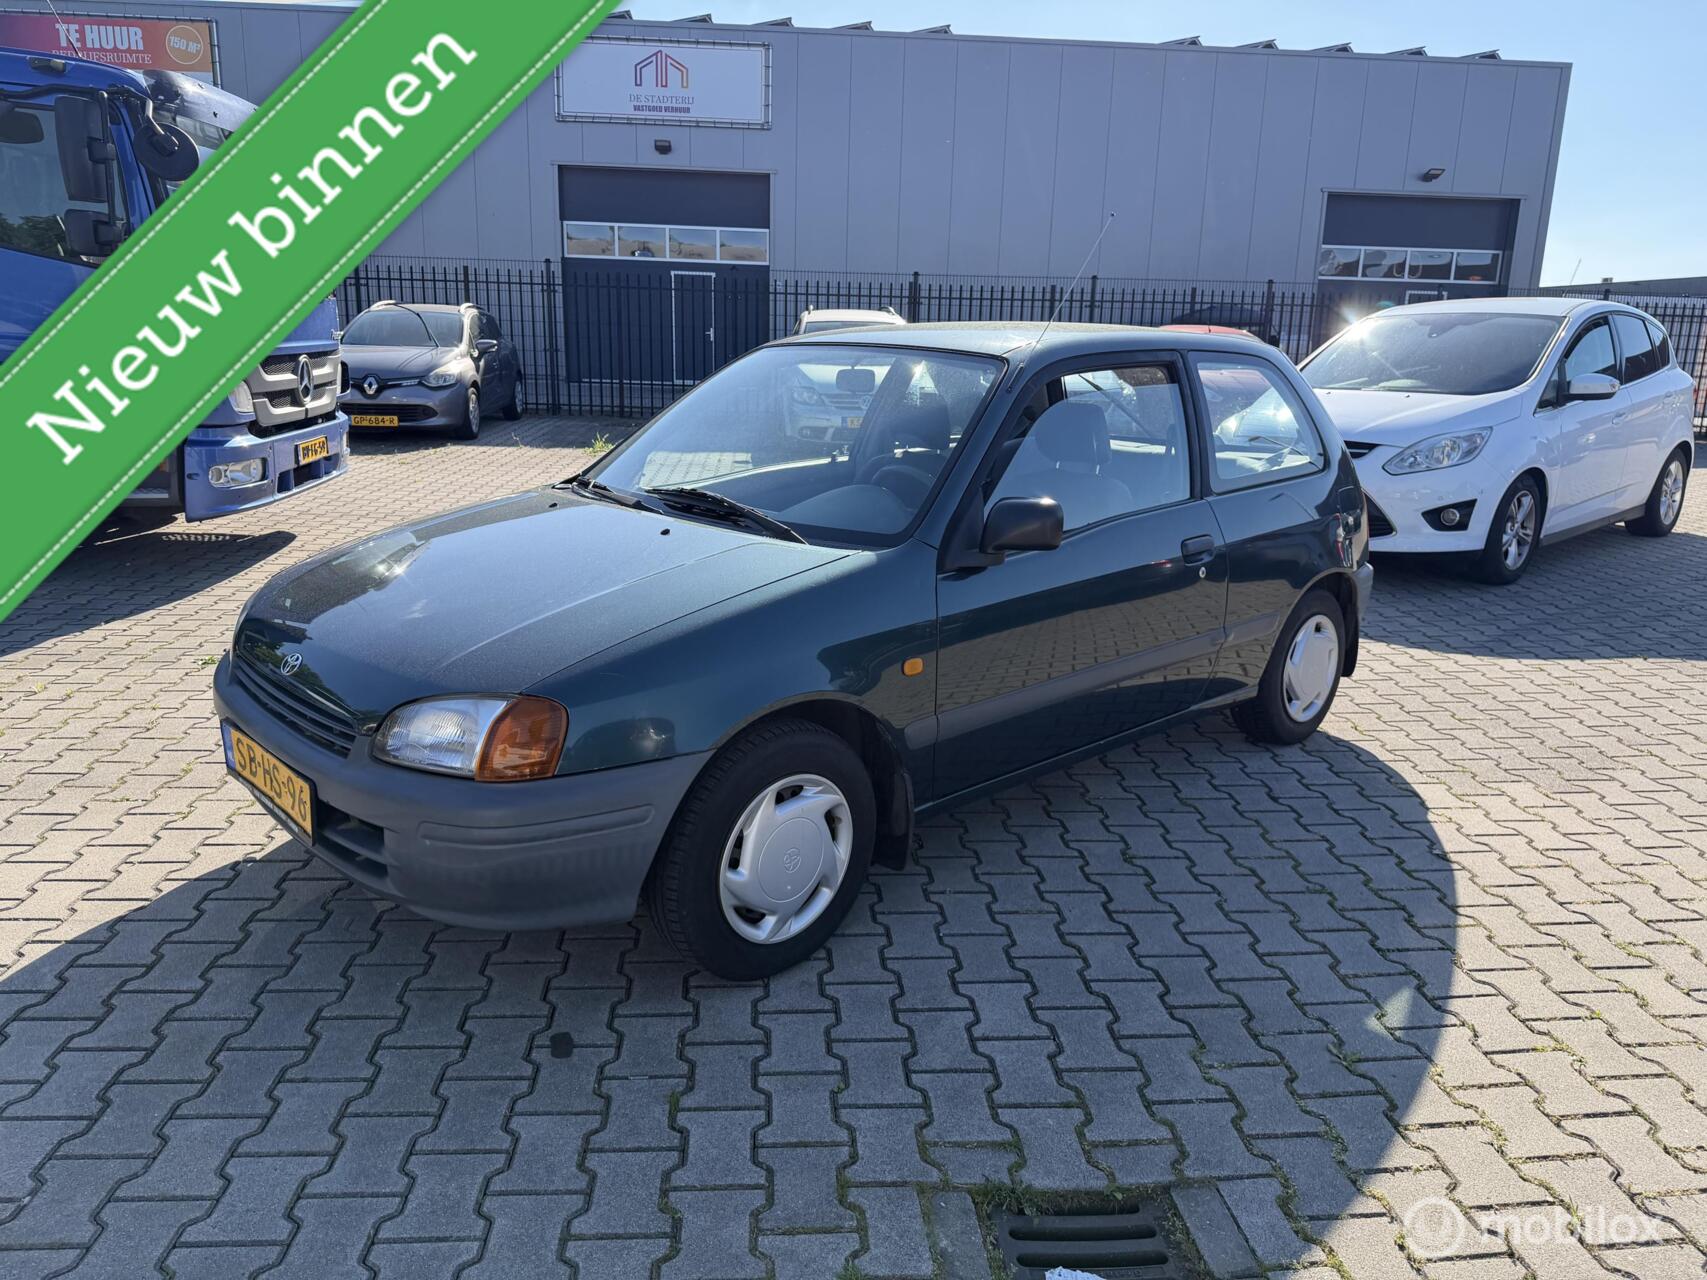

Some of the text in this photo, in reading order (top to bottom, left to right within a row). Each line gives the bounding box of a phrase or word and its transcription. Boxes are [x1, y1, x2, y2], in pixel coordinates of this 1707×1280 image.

[55, 23, 144, 50] TE HUUR
[169, 36, 187, 49] 150
[629, 94, 695, 104] DE STADTERIJ
[353, 416, 396, 425] GP-684-R
[236, 737, 307, 822] SB-HS-96
